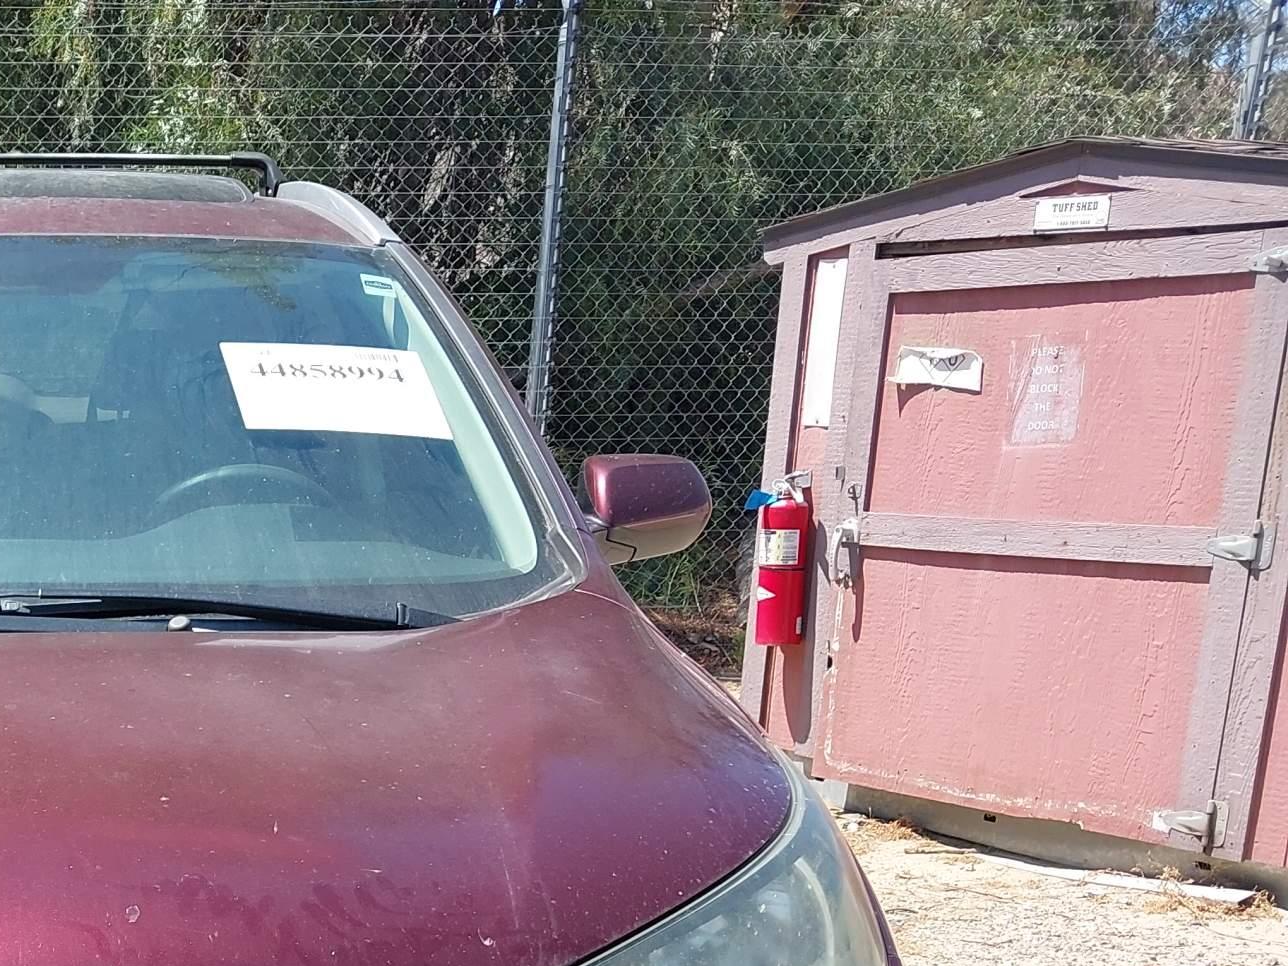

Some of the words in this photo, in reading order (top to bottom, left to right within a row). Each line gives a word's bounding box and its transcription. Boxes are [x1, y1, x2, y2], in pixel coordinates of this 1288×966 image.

[1052, 203, 1075, 213] TUFF
[1076, 201, 1099, 212] SHED
[1031, 346, 1065, 357] PLEASE
[250, 361, 405, 383] 44858994
[1034, 402, 1051, 412] THE
[1027, 420, 1055, 430] DOOR
